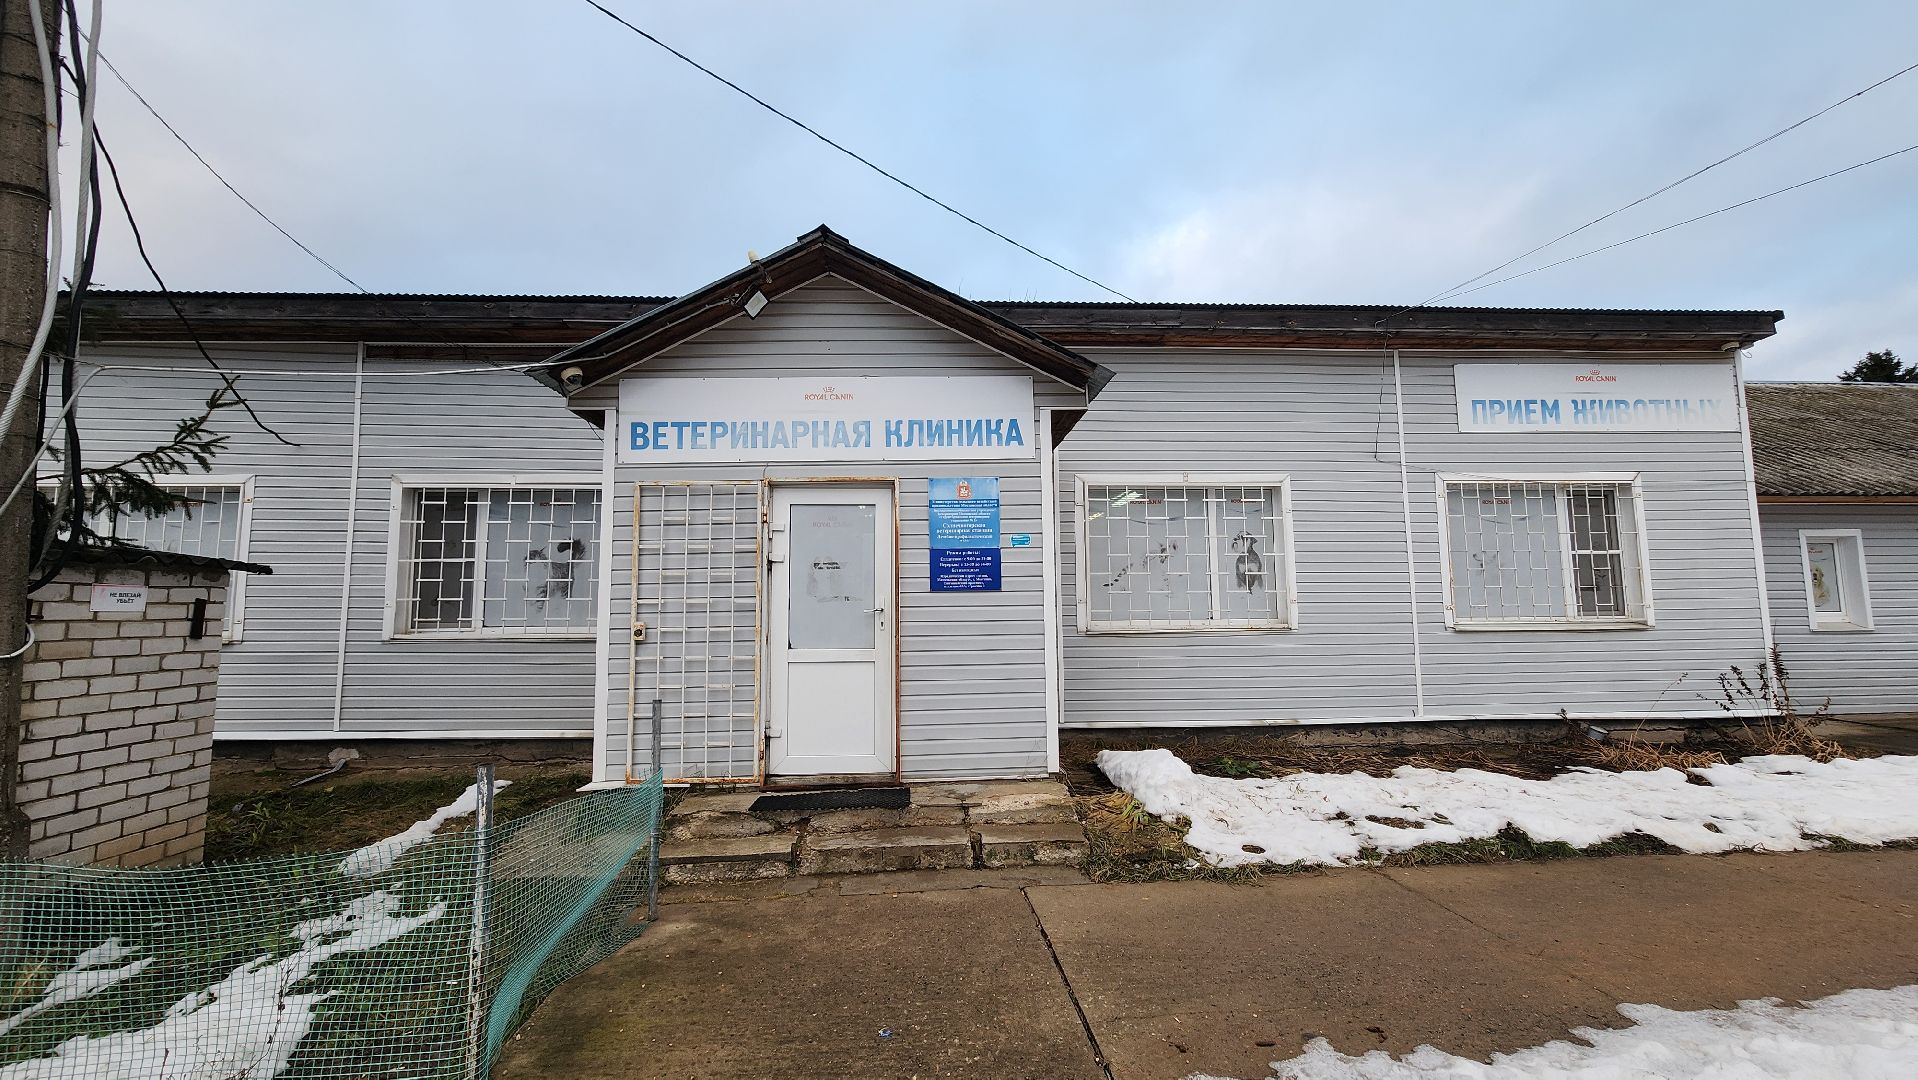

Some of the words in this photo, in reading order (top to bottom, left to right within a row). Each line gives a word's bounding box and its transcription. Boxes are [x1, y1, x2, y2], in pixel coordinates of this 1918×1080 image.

[804, 393, 828, 401] ROYAL
[829, 393, 854, 401] CANIN
[1471, 399, 1561, 425] ПРИЕМ
[1571, 399, 1723, 425] ЖИВОТНЫХ
[629, 420, 872, 451] ВЕТЕРИНАРНАЯ
[884, 418, 1025, 448] КЛИНИКА
